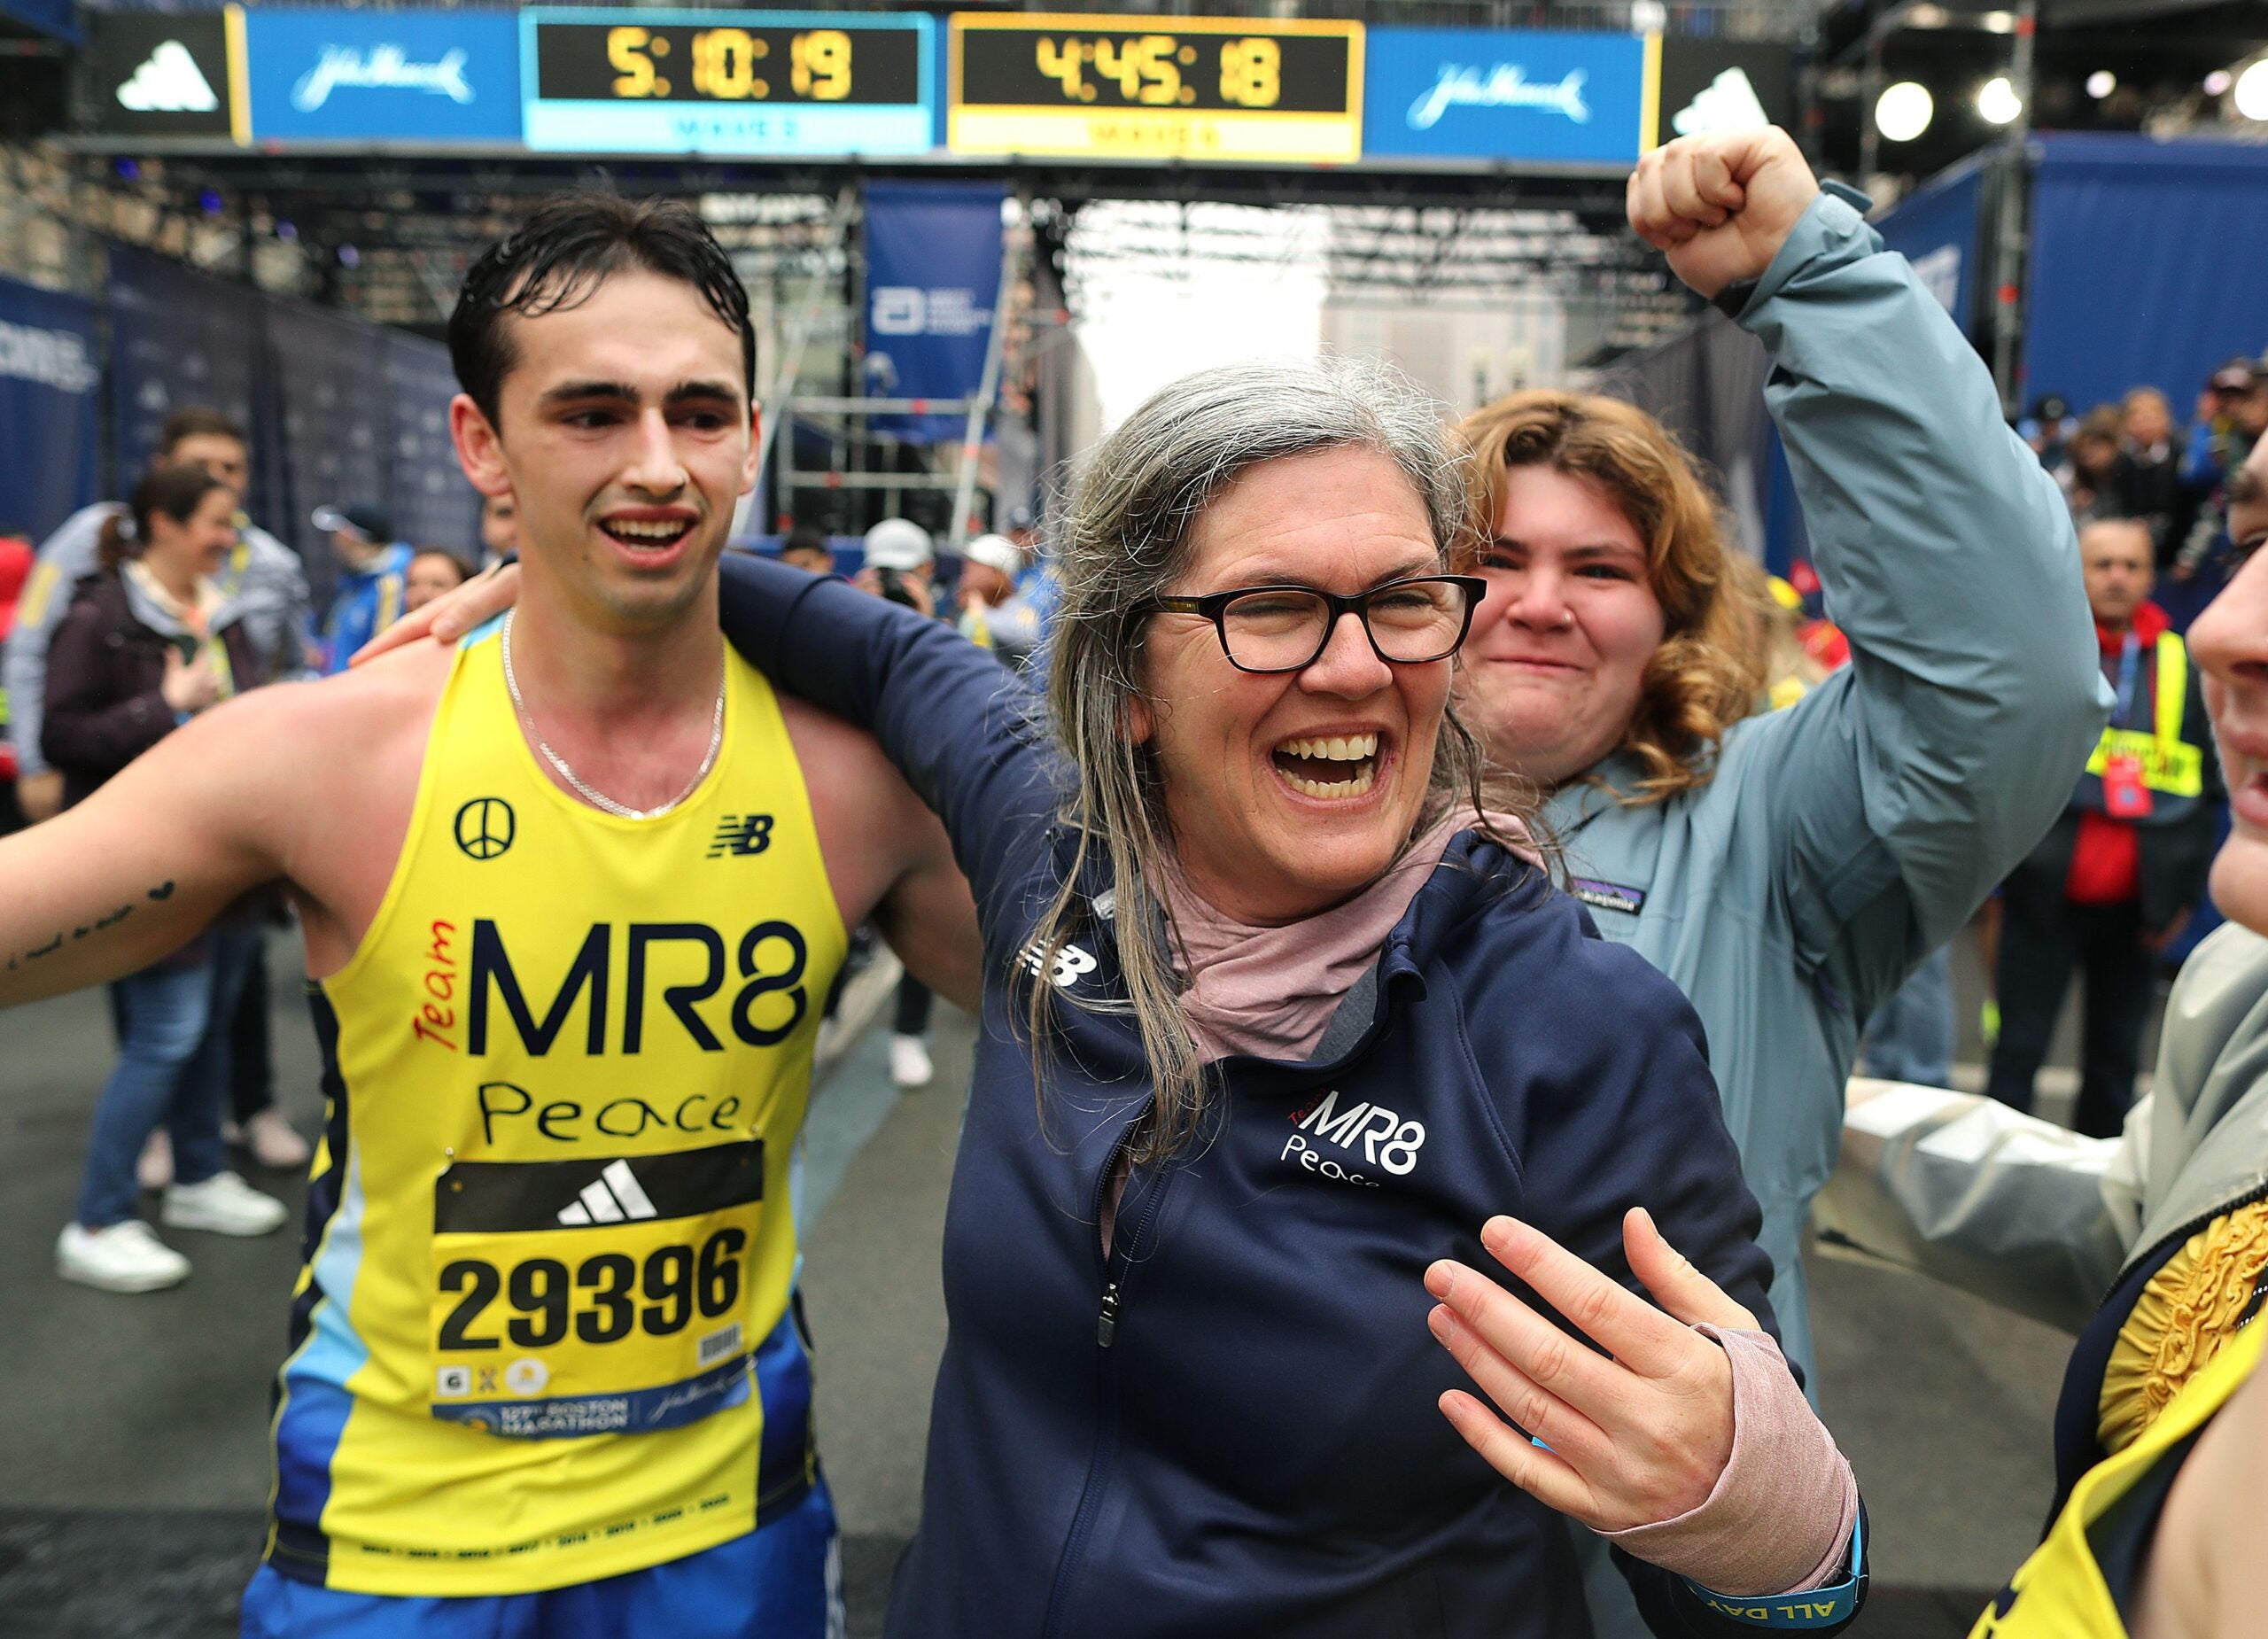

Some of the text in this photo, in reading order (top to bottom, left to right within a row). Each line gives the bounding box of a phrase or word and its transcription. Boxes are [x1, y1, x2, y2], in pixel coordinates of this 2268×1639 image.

[608, 26, 853, 100] 5:10:19
[1035, 34, 1281, 108] 4:45:18
[413, 919, 457, 1053] Team
[467, 918, 807, 1057] MR8
[478, 1082, 741, 1145] Peace
[1298, 1091, 1425, 1176] MR8
[439, 1227, 747, 1351] 29396
[1706, 1599, 1837, 1620] ALL DAY
